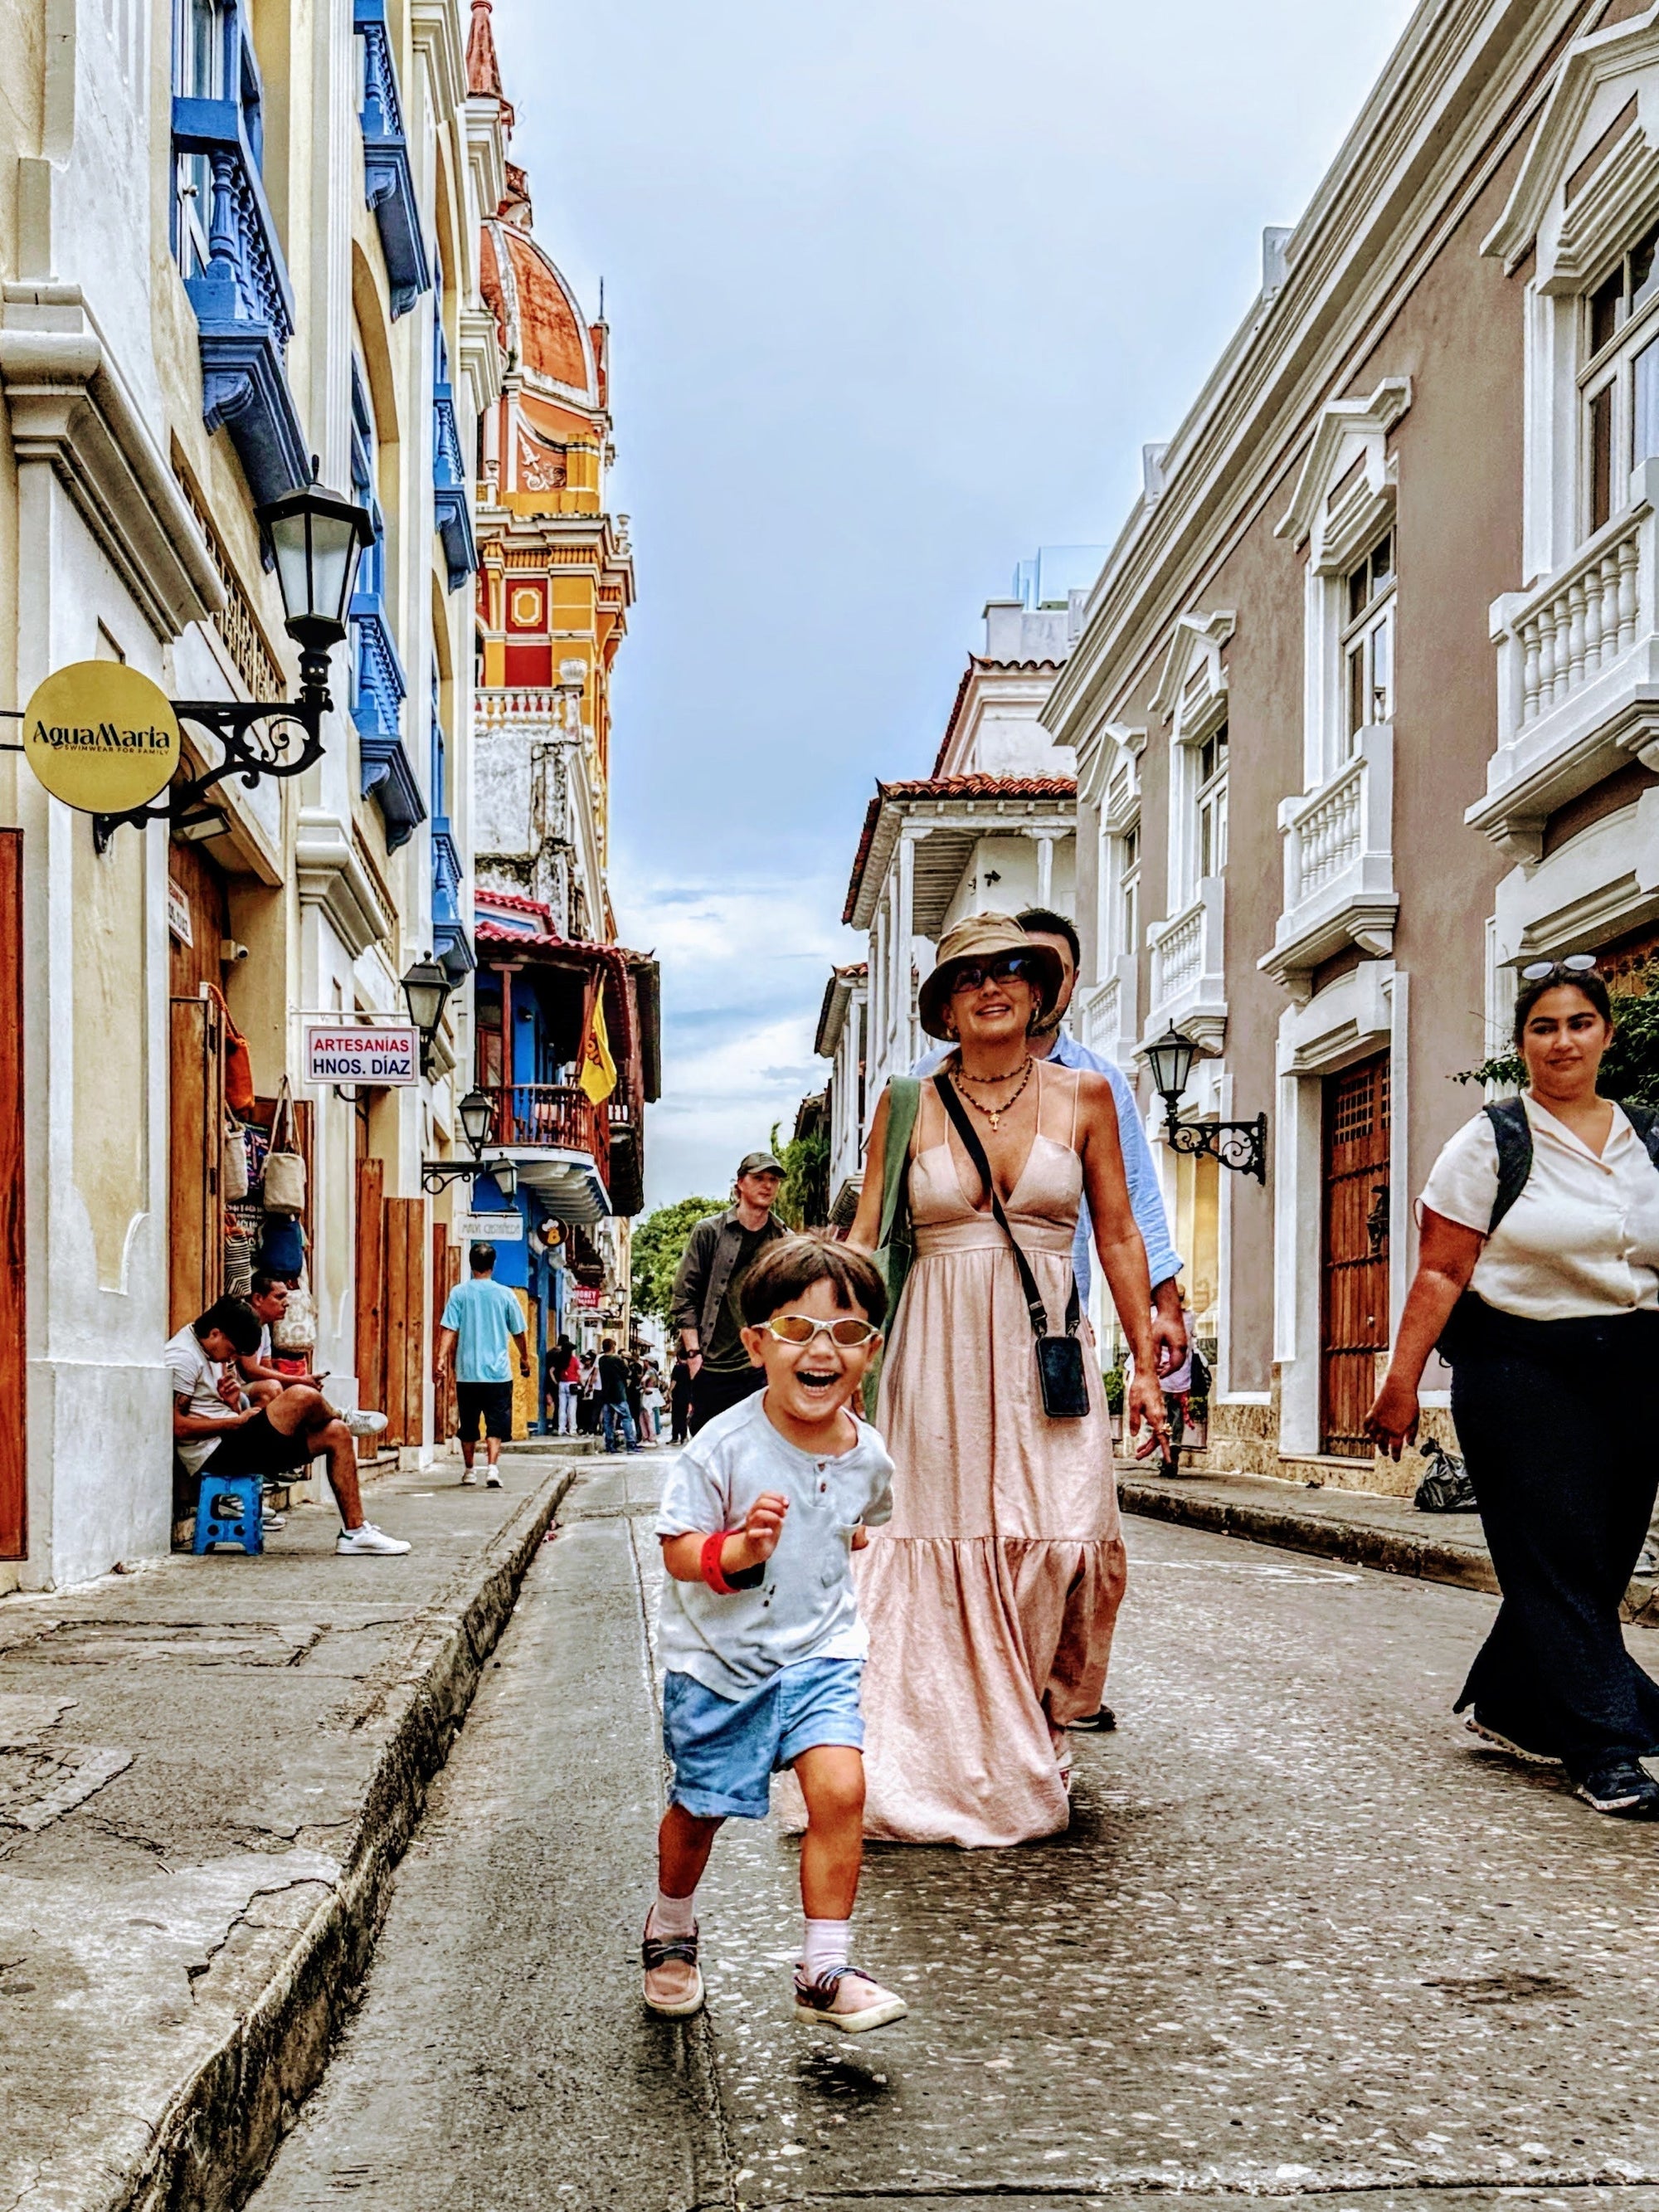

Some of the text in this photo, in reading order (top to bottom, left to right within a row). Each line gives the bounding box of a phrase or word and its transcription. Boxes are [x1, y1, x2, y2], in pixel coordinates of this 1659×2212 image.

[65, 744, 114, 753] SWIMWEAR
[314, 1035, 409, 1052] ARTESANÍAS
[314, 1055, 411, 1074] HNOS. DÍAZ
